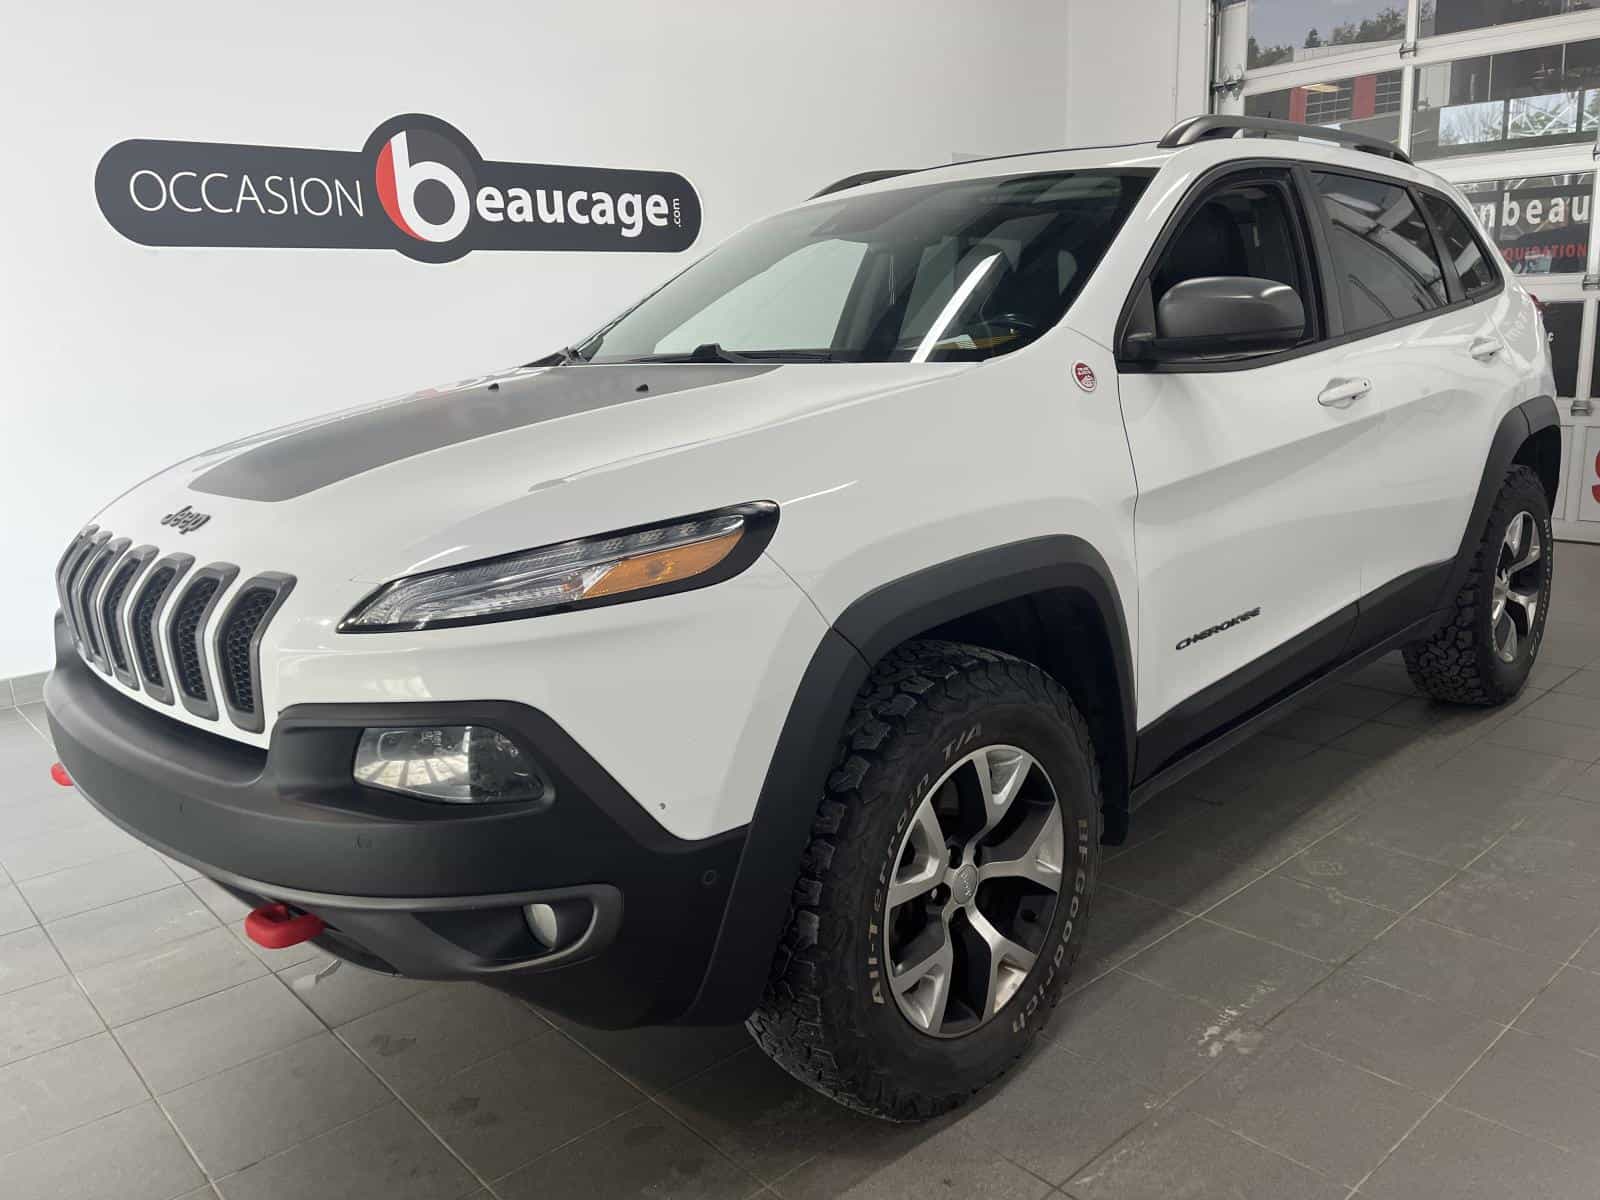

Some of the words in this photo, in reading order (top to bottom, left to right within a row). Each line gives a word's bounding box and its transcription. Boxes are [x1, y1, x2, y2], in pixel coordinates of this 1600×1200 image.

[129, 169, 364, 217] OCCASION
[1500, 243, 1586, 264] QUIDATION
[160, 505, 211, 535] Jeep
